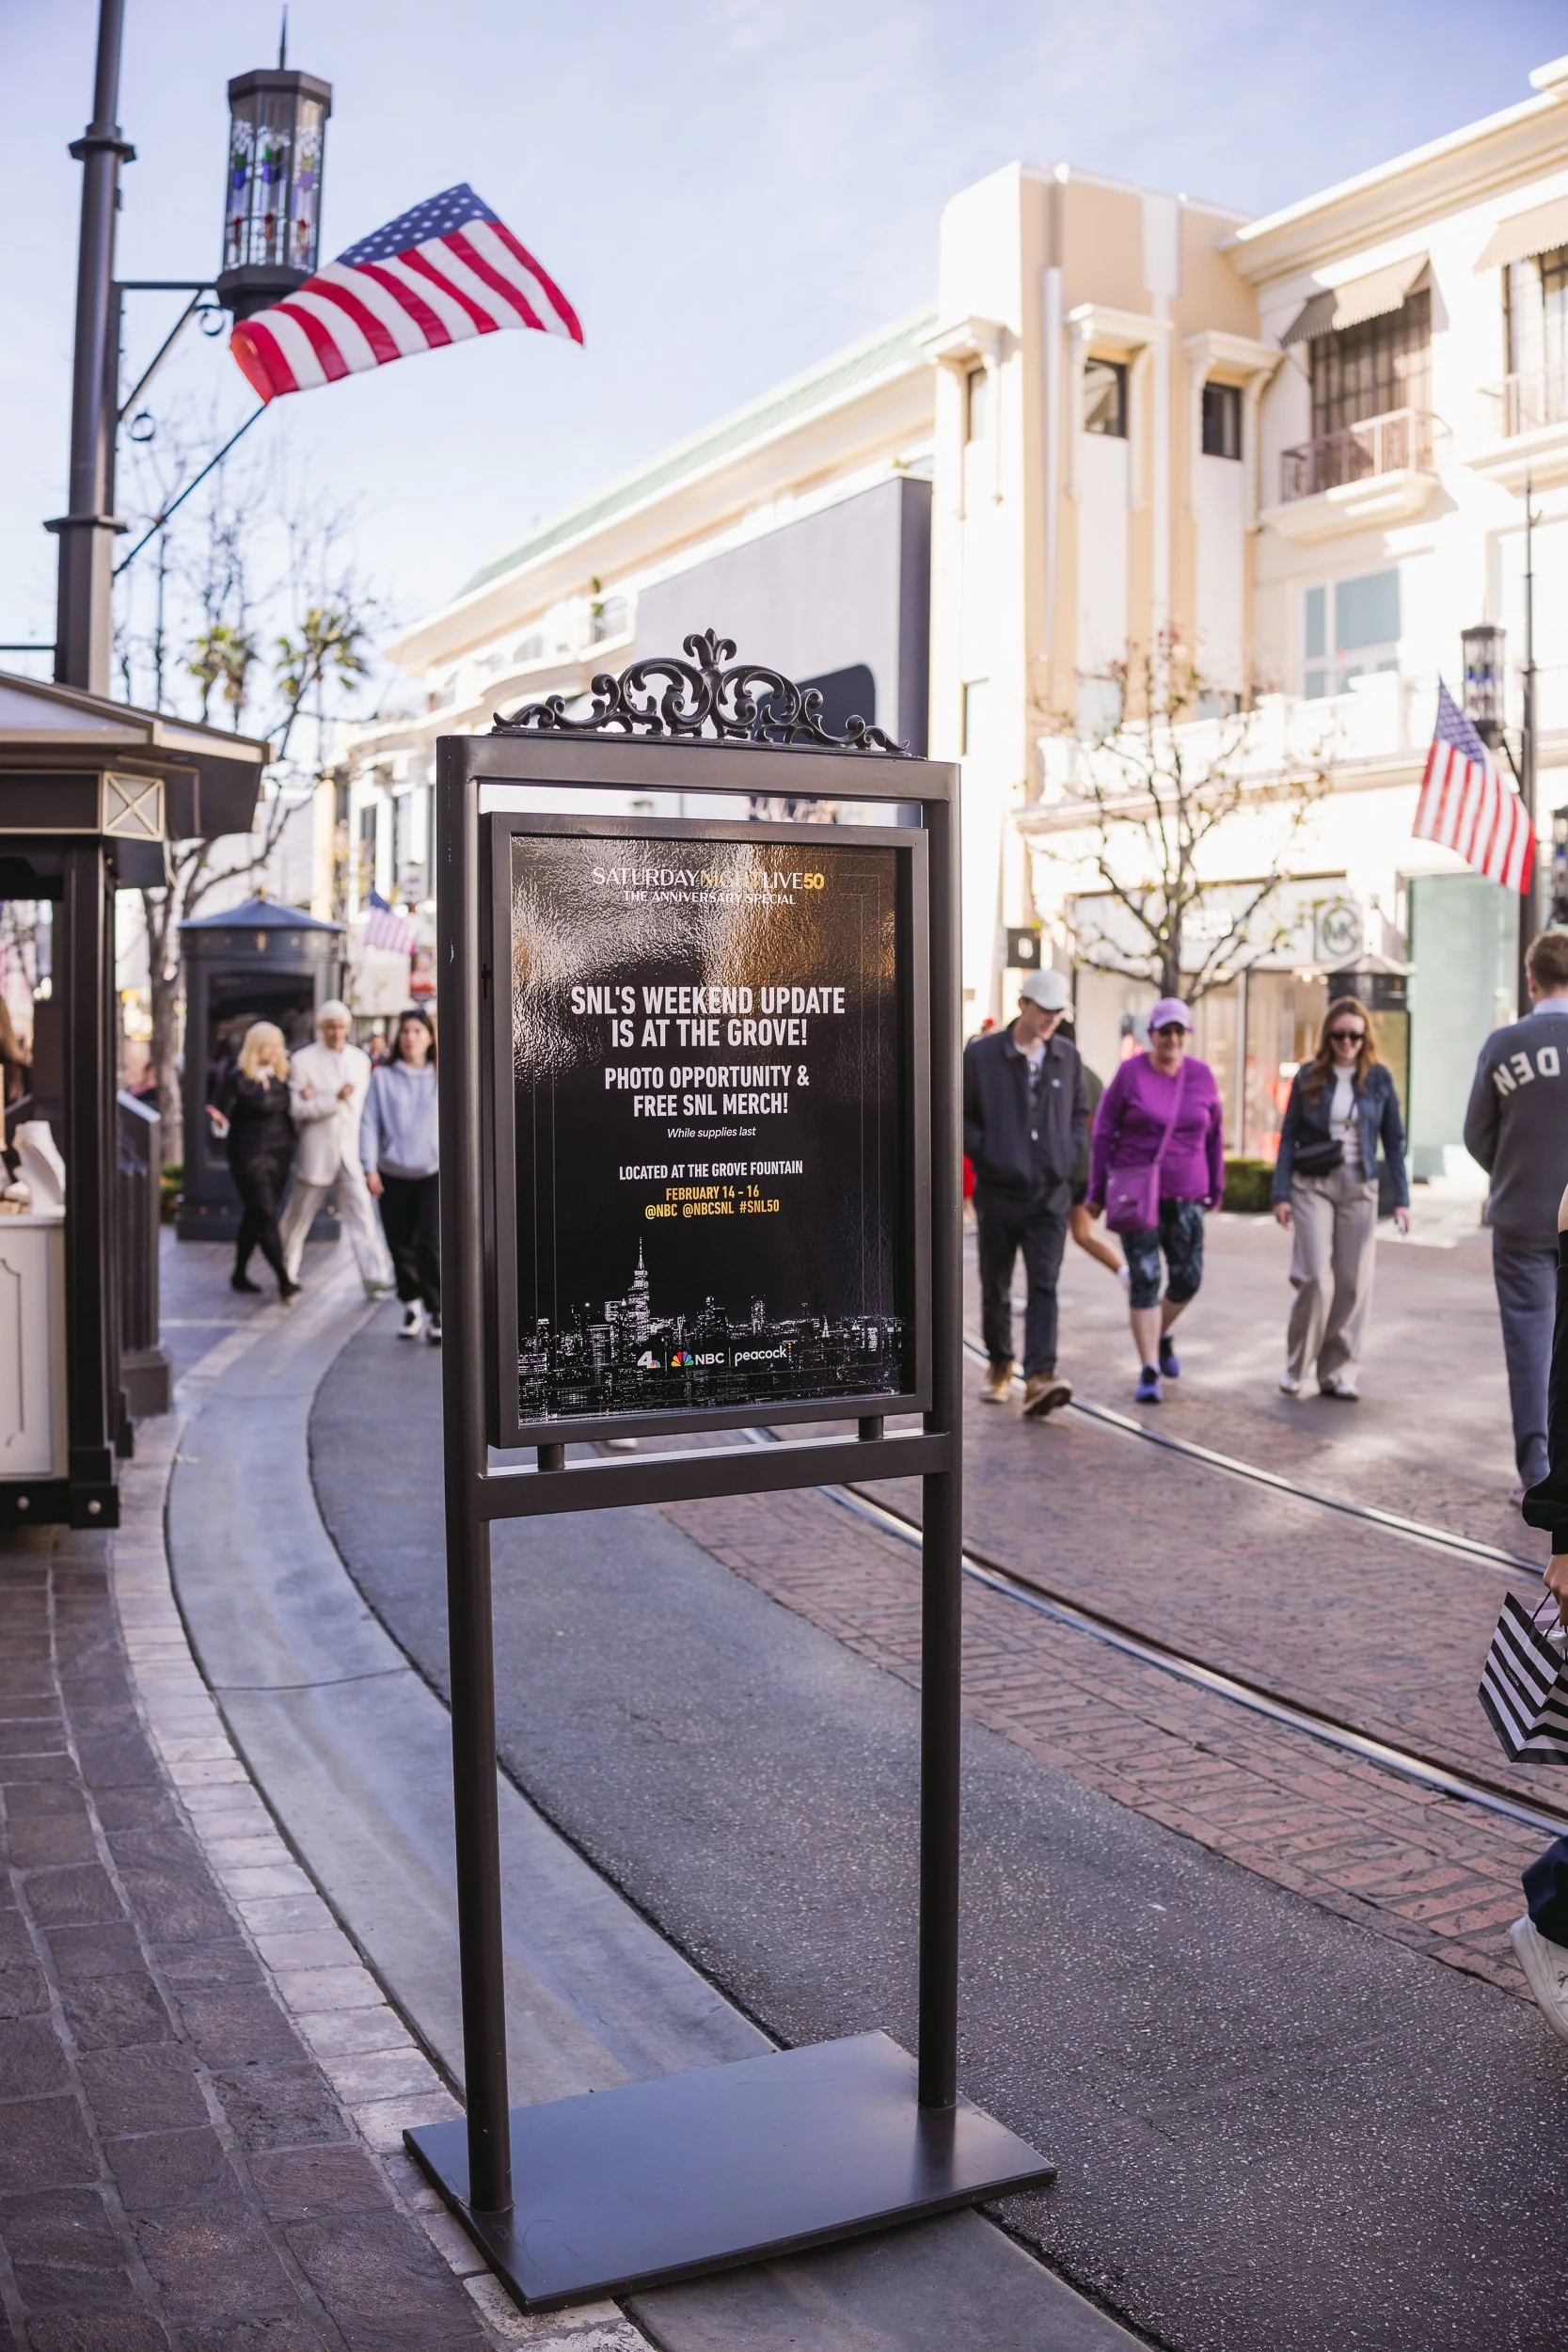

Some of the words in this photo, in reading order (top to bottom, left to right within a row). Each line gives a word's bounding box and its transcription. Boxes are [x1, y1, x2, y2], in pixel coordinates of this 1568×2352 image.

[623, 890, 649, 902] THE
[651, 890, 742, 904] ANNIVERSARY
[745, 892, 797, 905] SPECIAL
[571, 986, 636, 1015] SNL'S
[642, 986, 752, 1014] WEEKEND
[760, 987, 846, 1014] UPDATE
[611, 1019, 634, 1047] IS
[641, 1019, 670, 1047] AT
[676, 1019, 721, 1047] THE
[727, 1018, 807, 1046] GROVE!
[605, 1067, 664, 1089] PHOTO
[669, 1065, 792, 1089] OPPORTUNITY
[797, 1065, 810, 1087] &
[633, 1095, 677, 1118] FREE
[683, 1094, 717, 1117] SNL
[723, 1092, 788, 1115] MERCH!
[667, 1128, 696, 1138] While
[697, 1127, 737, 1139] supplies
[739, 1126, 757, 1136] last
[619, 1165, 668, 1181] LOCATED
[671, 1164, 686, 1179] AT
[688, 1164, 709, 1178] THE
[711, 1162, 748, 1177] GROVE
[751, 1160, 803, 1175] FOUNTAIN
[666, 1185, 720, 1201] FEBRUARY
[721, 1185, 736, 1199] 14
[747, 1184, 760, 1198] 16
[644, 1203, 678, 1220] @NBC
[682, 1200, 735, 1218] @NBCSNL
[739, 1199, 780, 1214] #SNL50
[637, 1350, 655, 1369] 4
[694, 1352, 725, 1366] NBC
[734, 1345, 787, 1367] peacock
